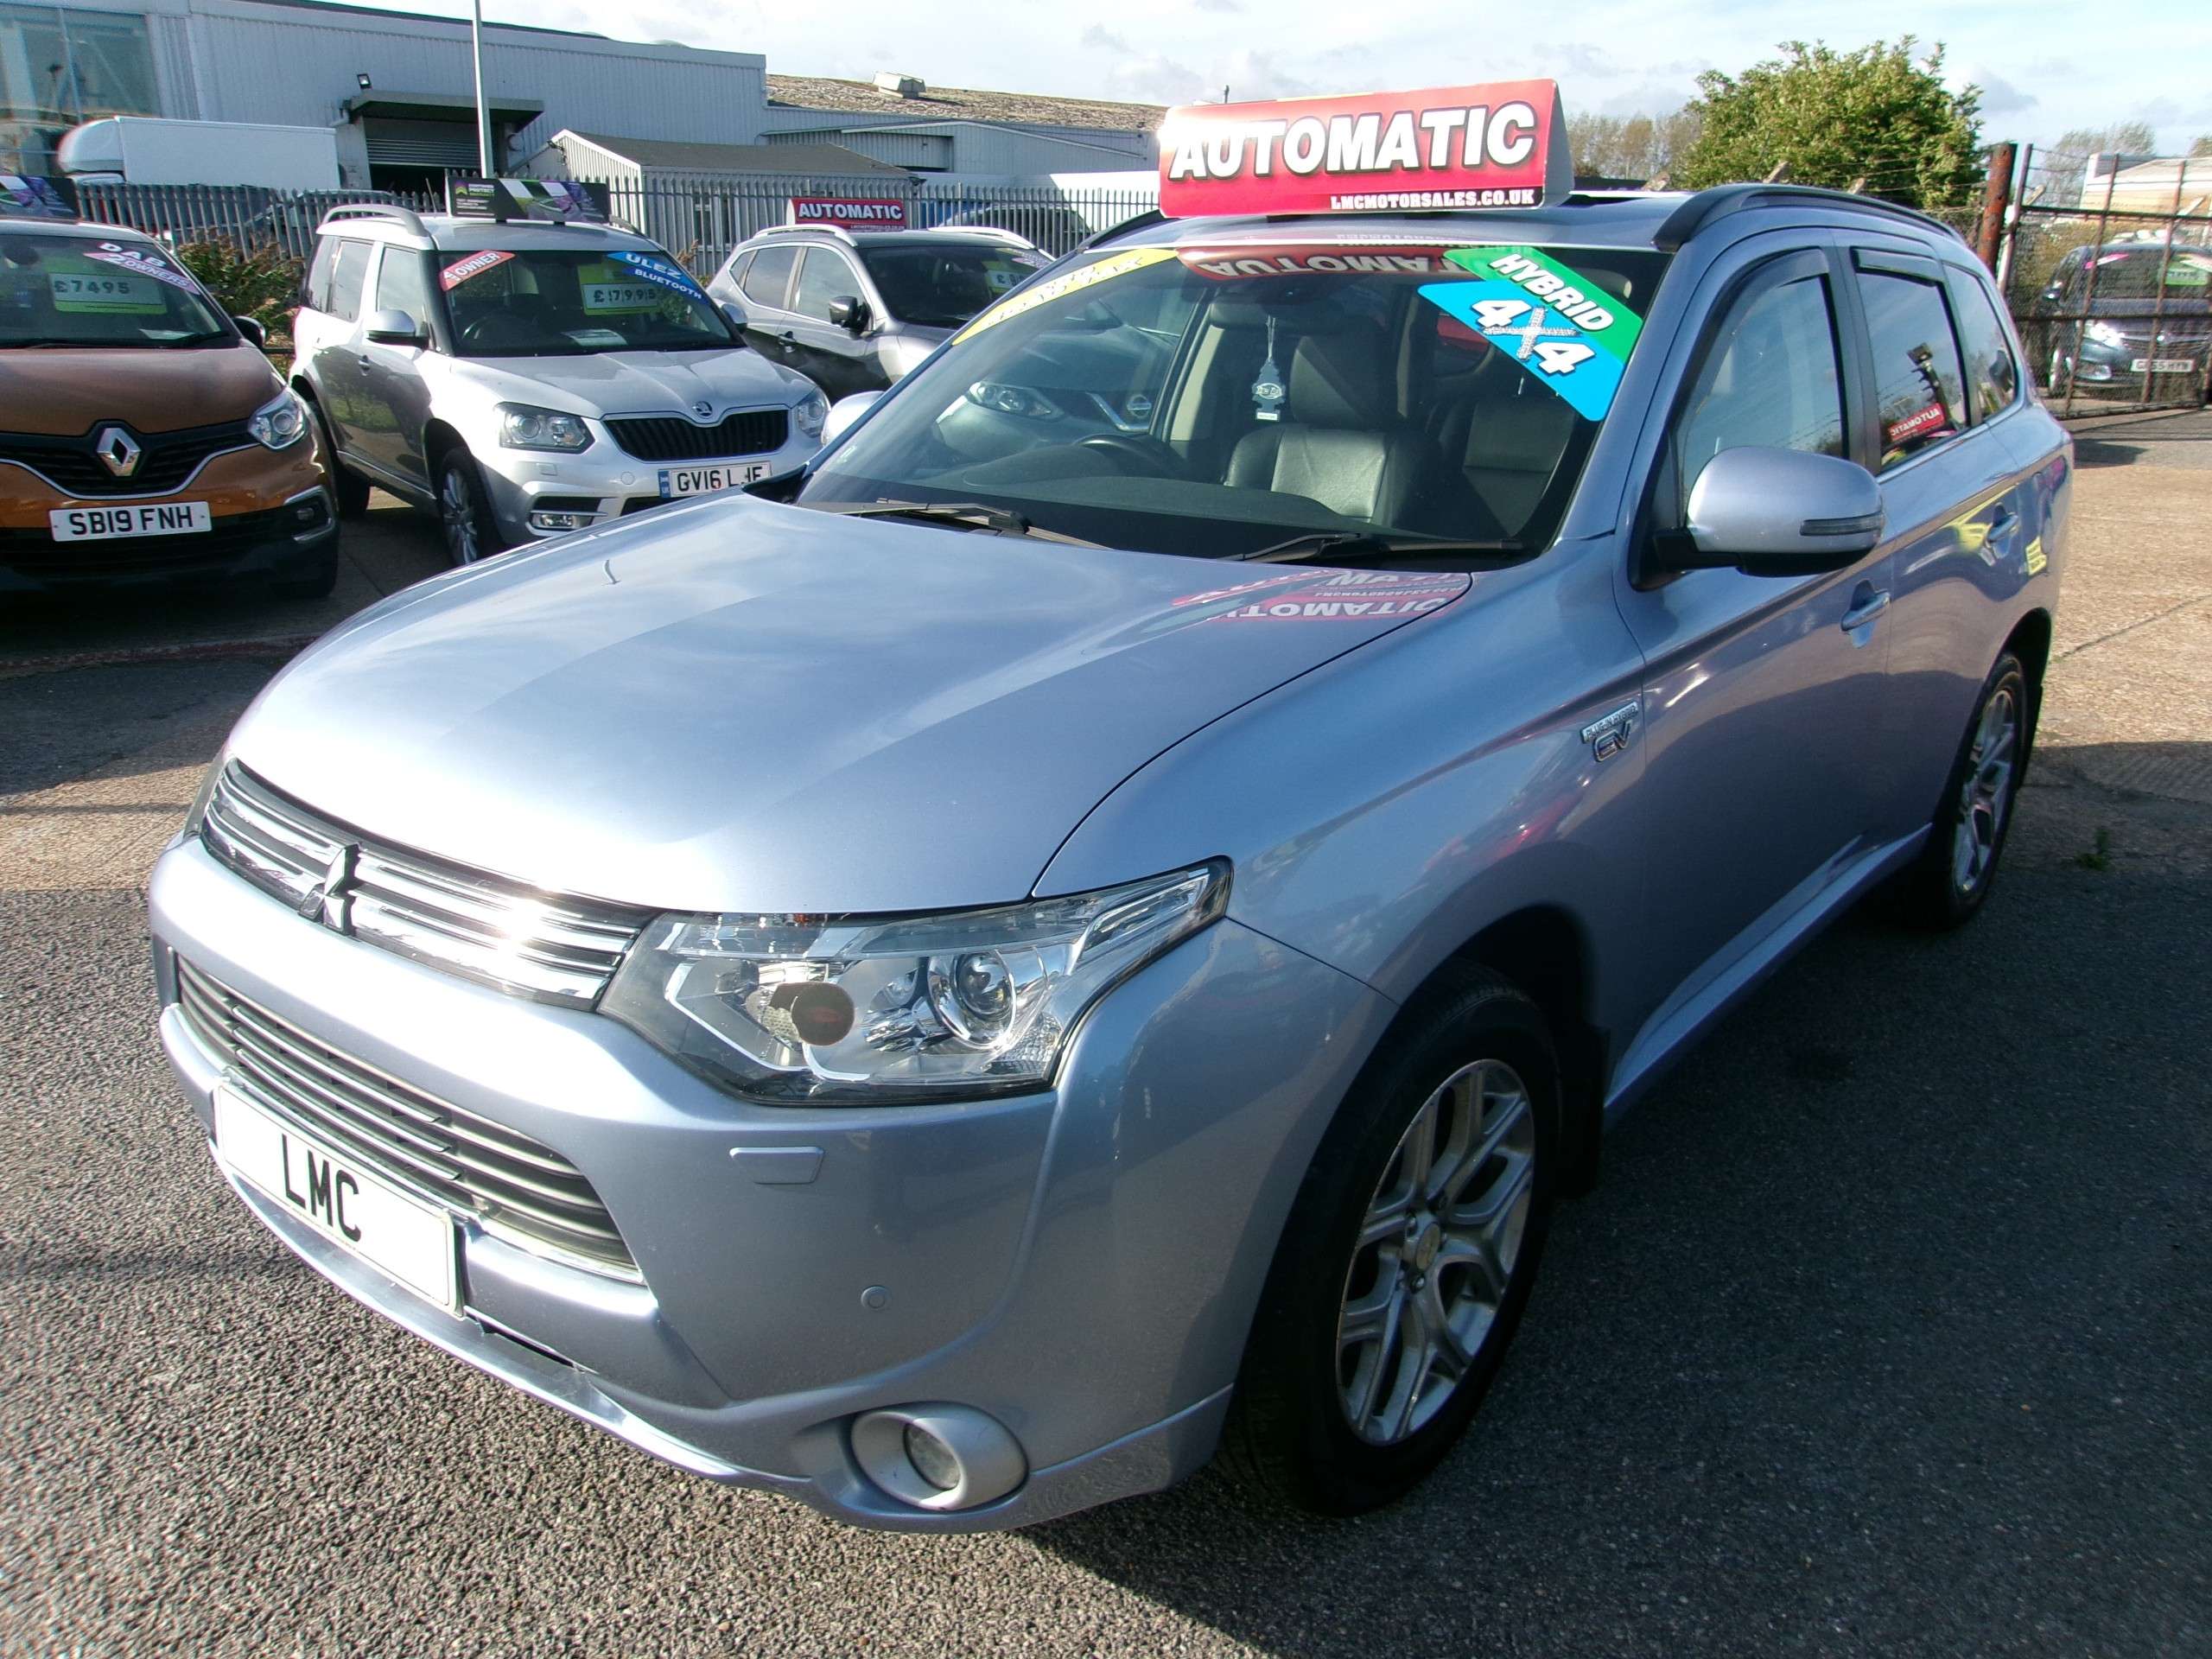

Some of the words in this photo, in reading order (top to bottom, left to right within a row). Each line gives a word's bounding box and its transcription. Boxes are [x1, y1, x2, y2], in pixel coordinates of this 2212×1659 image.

[1168, 102, 1535, 181] AUTOMATIC
[798, 203, 902, 219] AUTOMATIC
[1330, 189, 1534, 211] LMCMOTORSALES.CO.UK
[100, 243, 165, 265] DAB
[454, 252, 501, 276] OWNER
[625, 252, 682, 279] ULEZ
[124, 259, 189, 287] OWNERS
[634, 269, 702, 300] BLUETOOTH
[54, 280, 130, 294] £7495
[1489, 253, 1614, 331] HYBRID
[677, 470, 721, 492] GV16
[69, 510, 132, 537] SB19
[138, 505, 194, 531] FNH
[1595, 720, 1632, 761] EV
[282, 1134, 361, 1243] LMC
